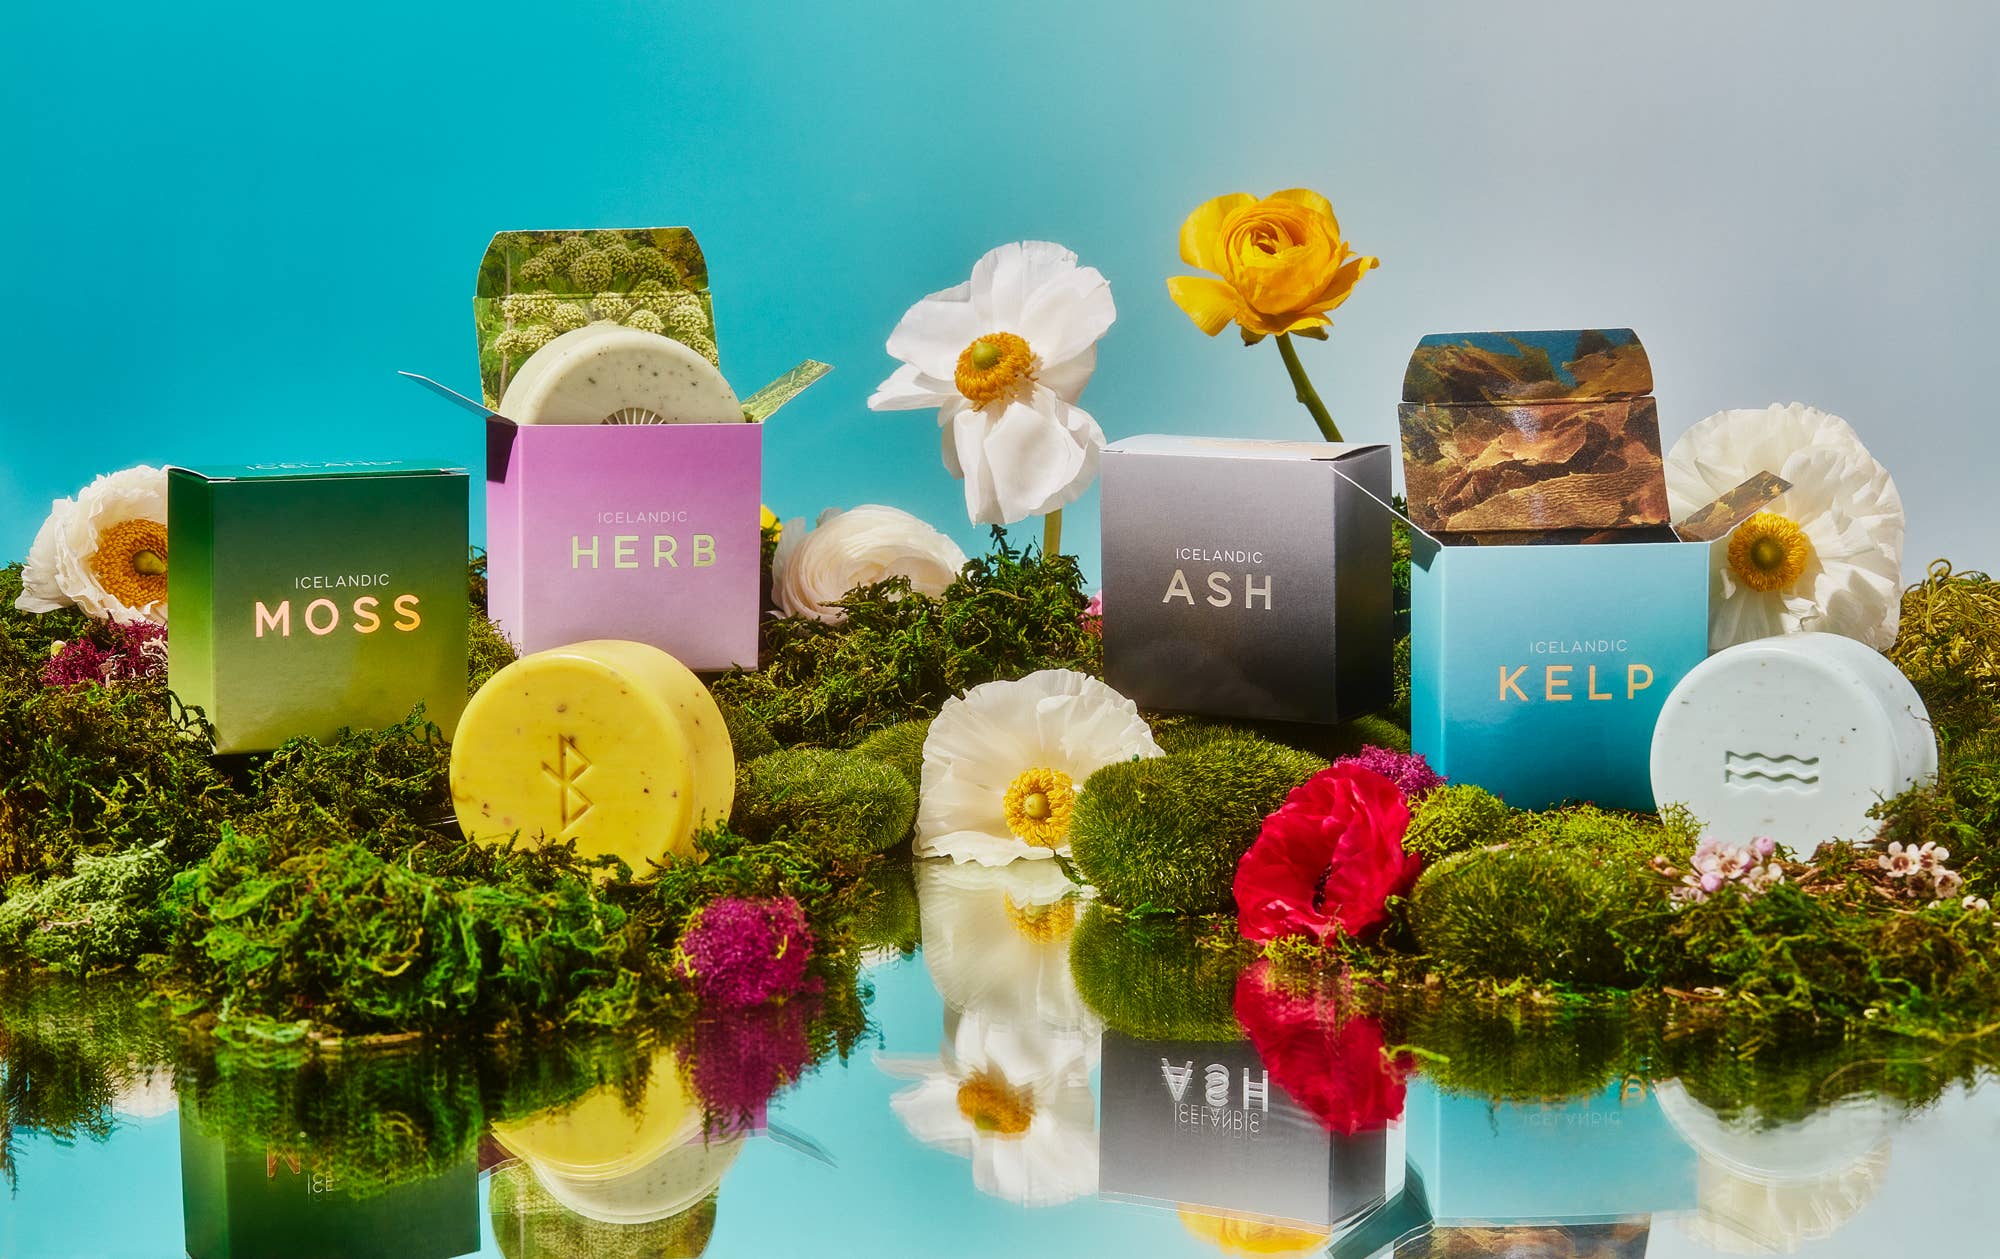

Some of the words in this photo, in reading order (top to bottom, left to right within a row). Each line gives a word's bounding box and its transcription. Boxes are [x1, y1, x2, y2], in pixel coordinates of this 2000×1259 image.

[598, 511, 688, 524] ICELANDIC
[572, 535, 717, 569] HERB
[1175, 548, 1263, 564] ICELANDIC
[295, 573, 390, 589] ICELANDIC
[1162, 569, 1272, 610] ASH
[255, 594, 422, 638] MOSS
[1529, 639, 1628, 654] ICELANDIC
[1498, 664, 1654, 701] KELP
